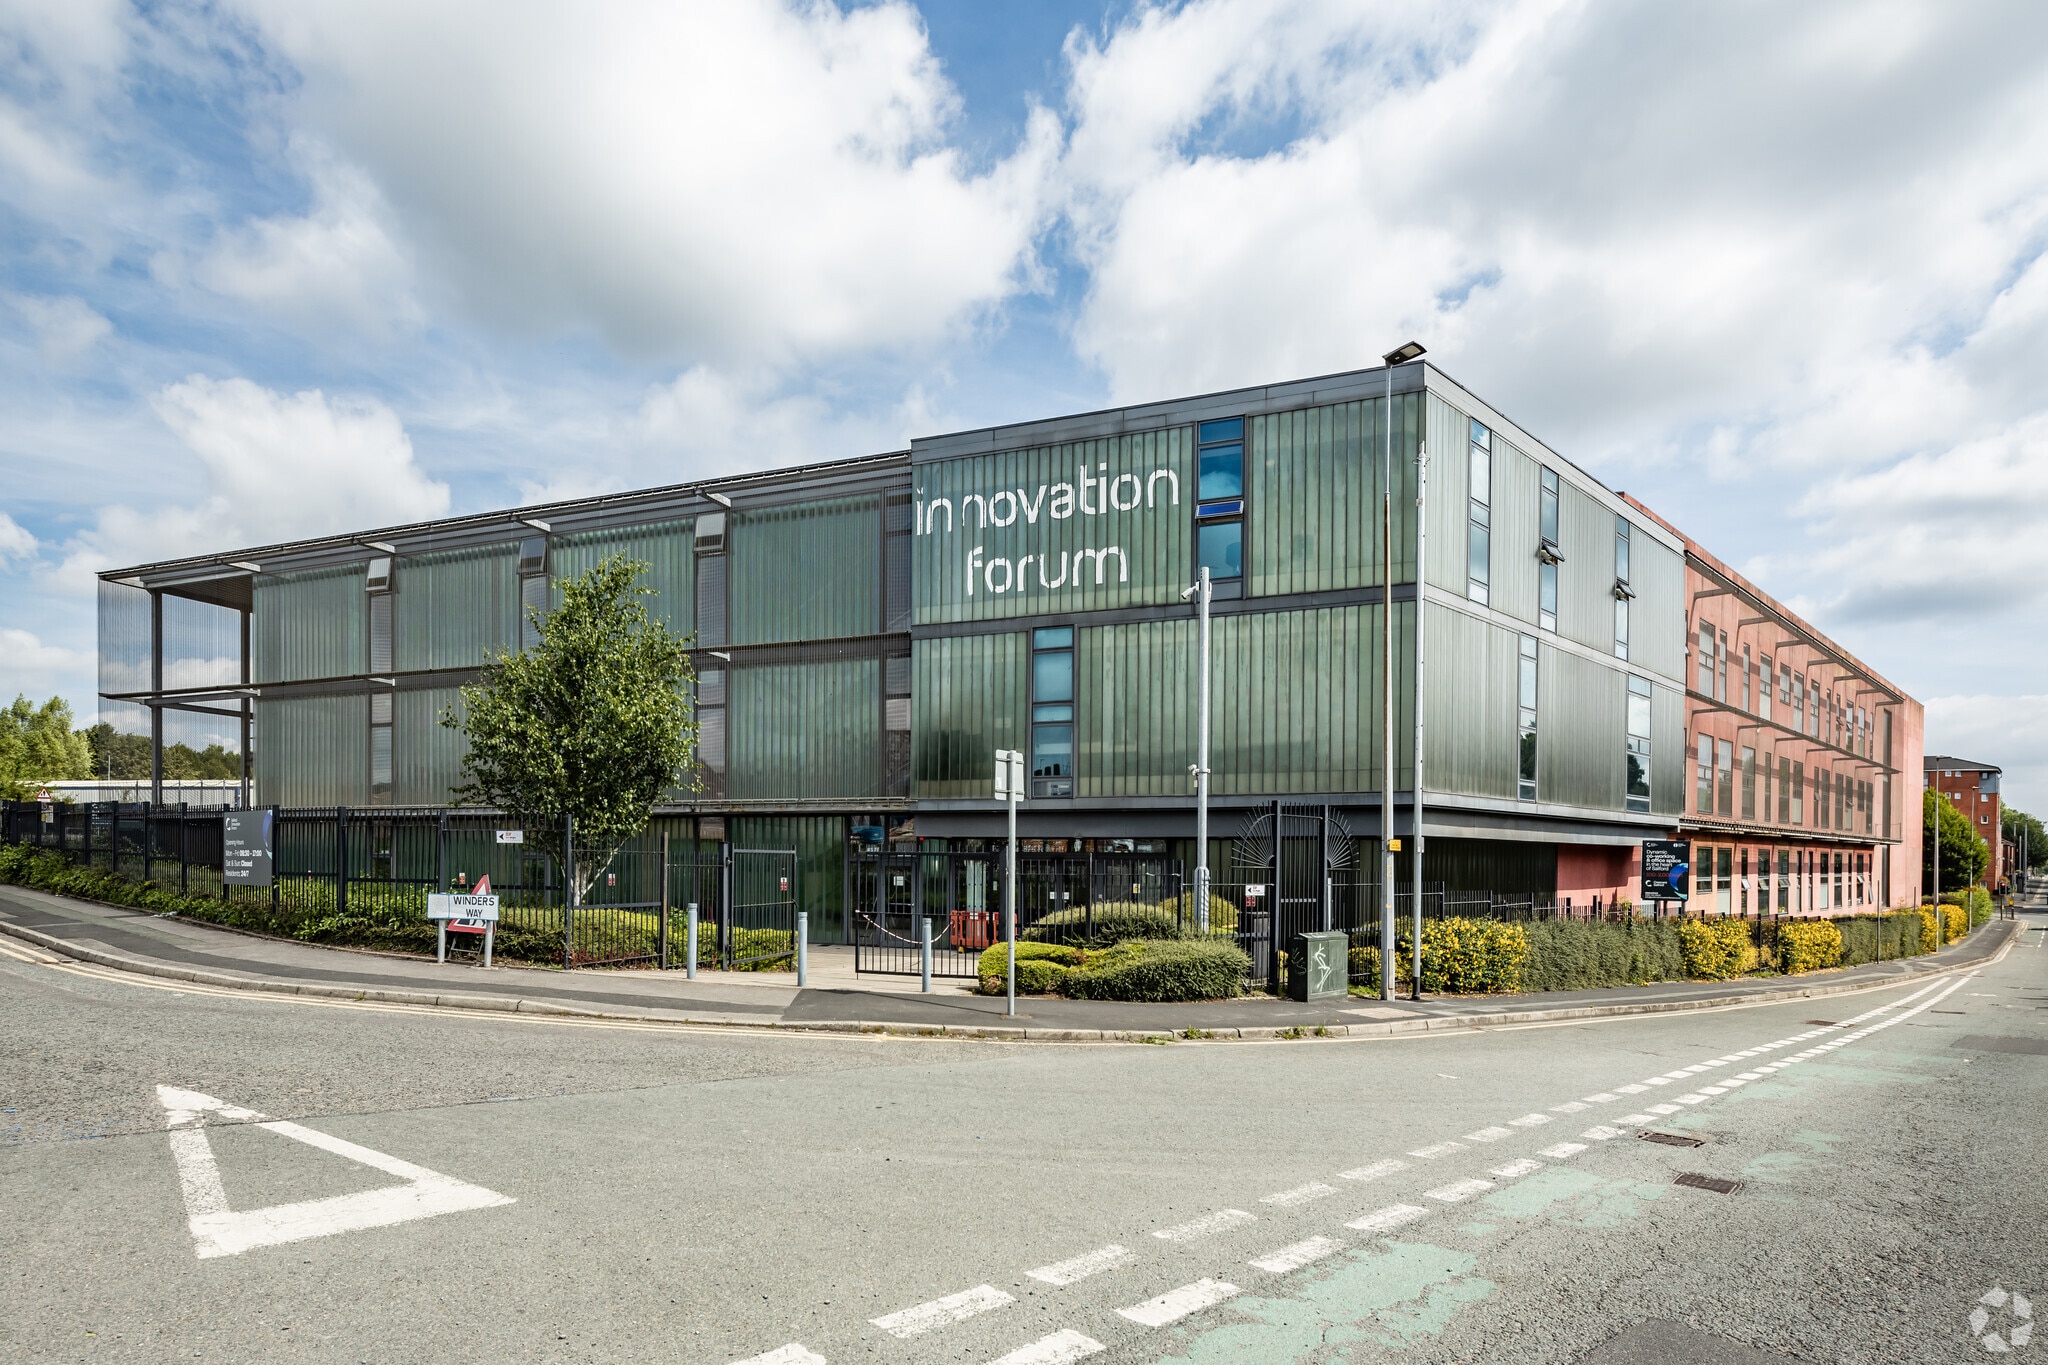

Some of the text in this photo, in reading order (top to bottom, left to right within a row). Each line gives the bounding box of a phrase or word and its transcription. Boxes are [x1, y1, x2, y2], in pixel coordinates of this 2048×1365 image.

[916, 462, 1179, 535] innovation
[967, 545, 1127, 596] forum
[453, 896, 495, 906] WINDERS
[466, 909, 483, 918] WAY
